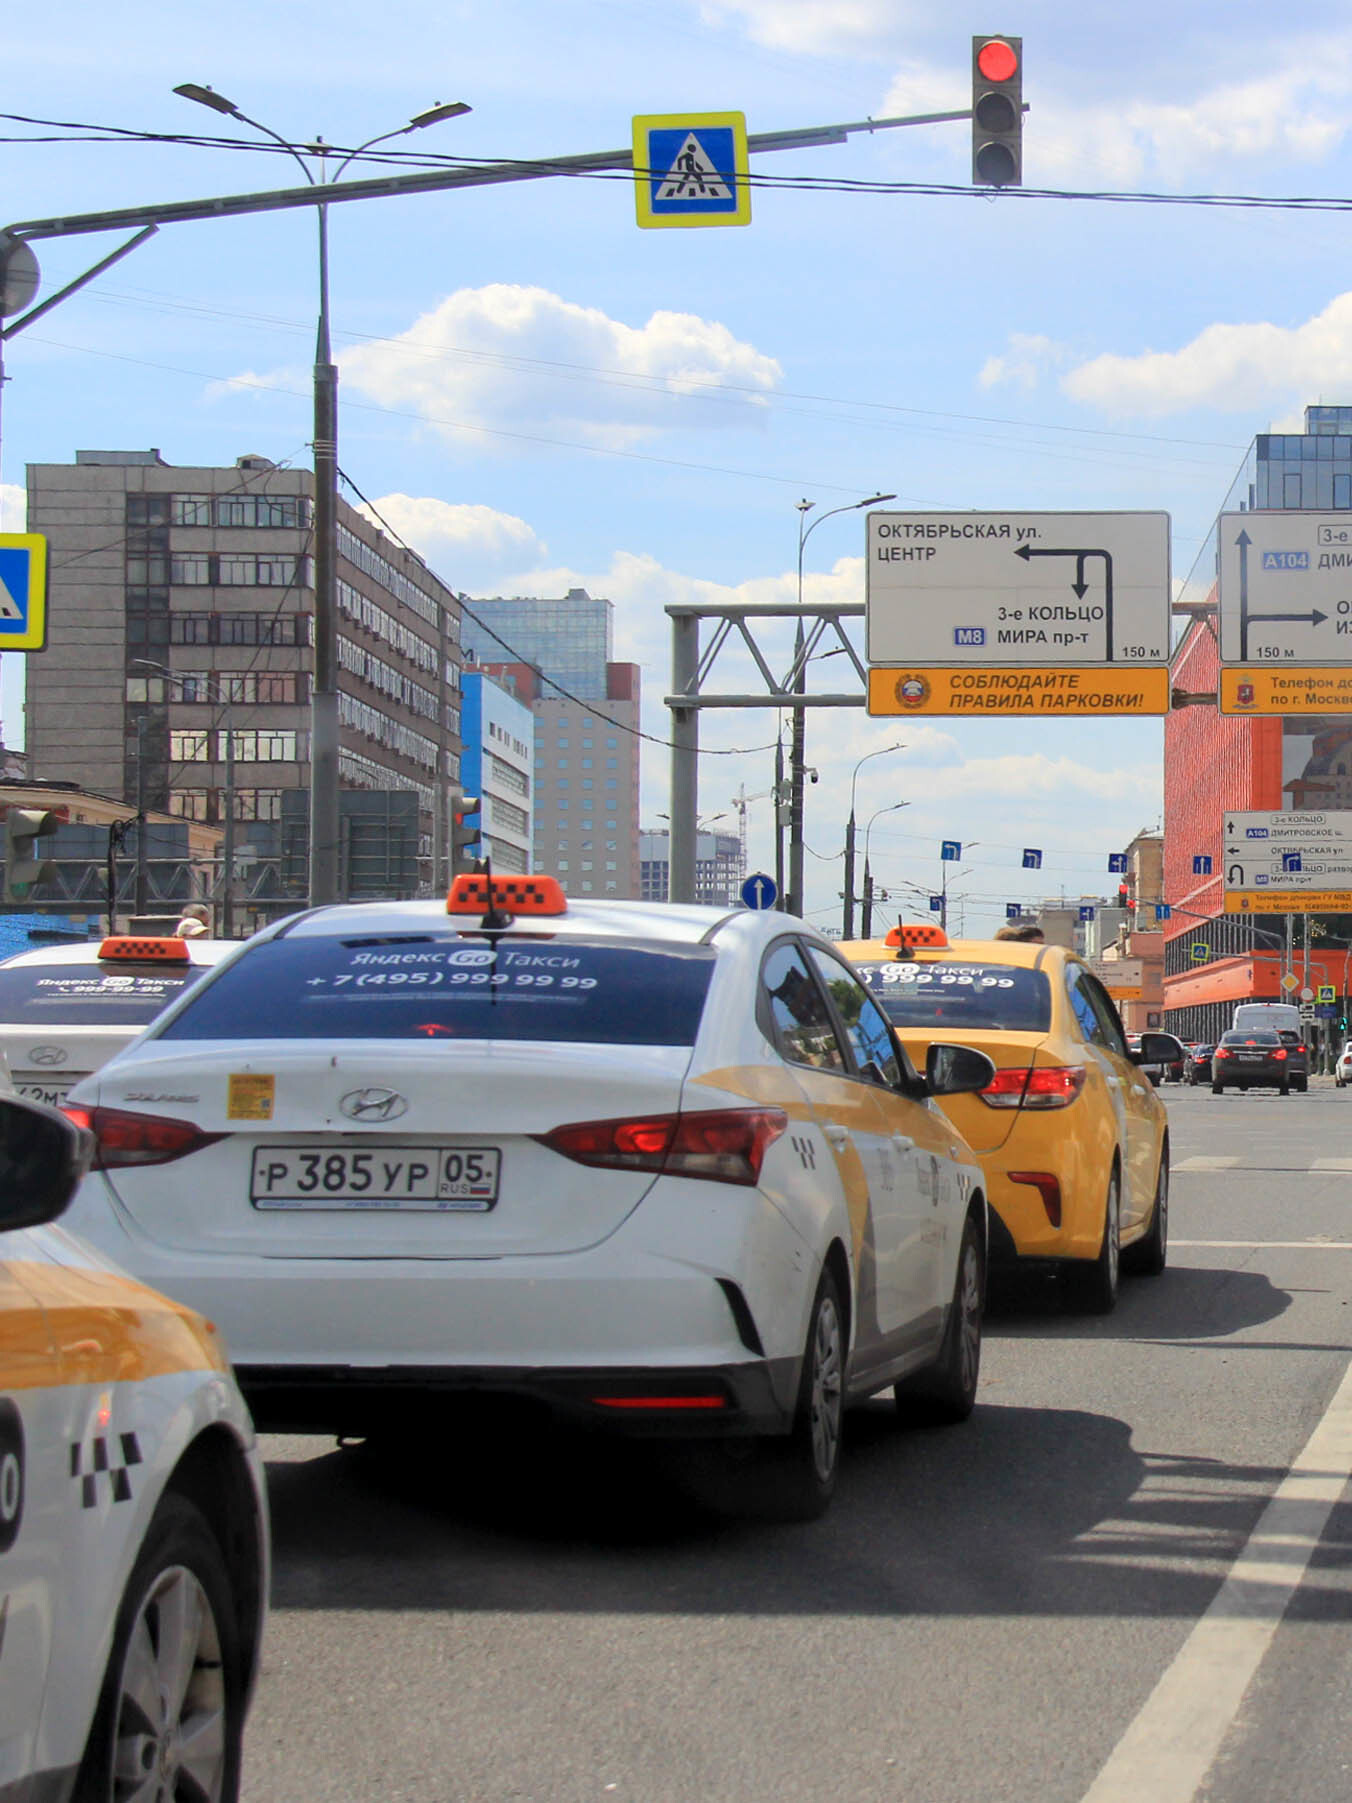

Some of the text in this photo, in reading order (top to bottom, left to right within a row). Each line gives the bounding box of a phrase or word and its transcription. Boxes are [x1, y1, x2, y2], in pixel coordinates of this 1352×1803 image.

[877, 524, 1042, 542] ОКТЯБРЬСКАЯ ул.
[1322, 528, 1348, 543] 3-е
[877, 547, 937, 563] ЦЕНТР
[997, 606, 1104, 624] 3-е КОЛЬЦО
[997, 630, 1089, 648] МИРА пр-т
[1122, 646, 1161, 658] 150 м
[1256, 647, 1295, 658] 150 м
[949, 672, 1081, 690] СОБЛЮДАЙТЕ
[1271, 676, 1334, 691] Телефон
[949, 693, 1144, 709] ПРАВИЛА ПАРКОВКИ!
[1270, 694, 1289, 706] по
[1292, 694, 1302, 705] г.
[1287, 815, 1324, 824] КОЛЬЦО
[1270, 829, 1333, 838] ДМИТРОВСКОЕ
[350, 953, 446, 966] Яндекс
[504, 952, 581, 969] Такси
[927, 964, 984, 977] Такси
[37, 978, 99, 986] Яндекс
[136, 978, 185, 986] Такси
[444, 1153, 484, 1183] 05
[440, 1183, 469, 1194] RUS
